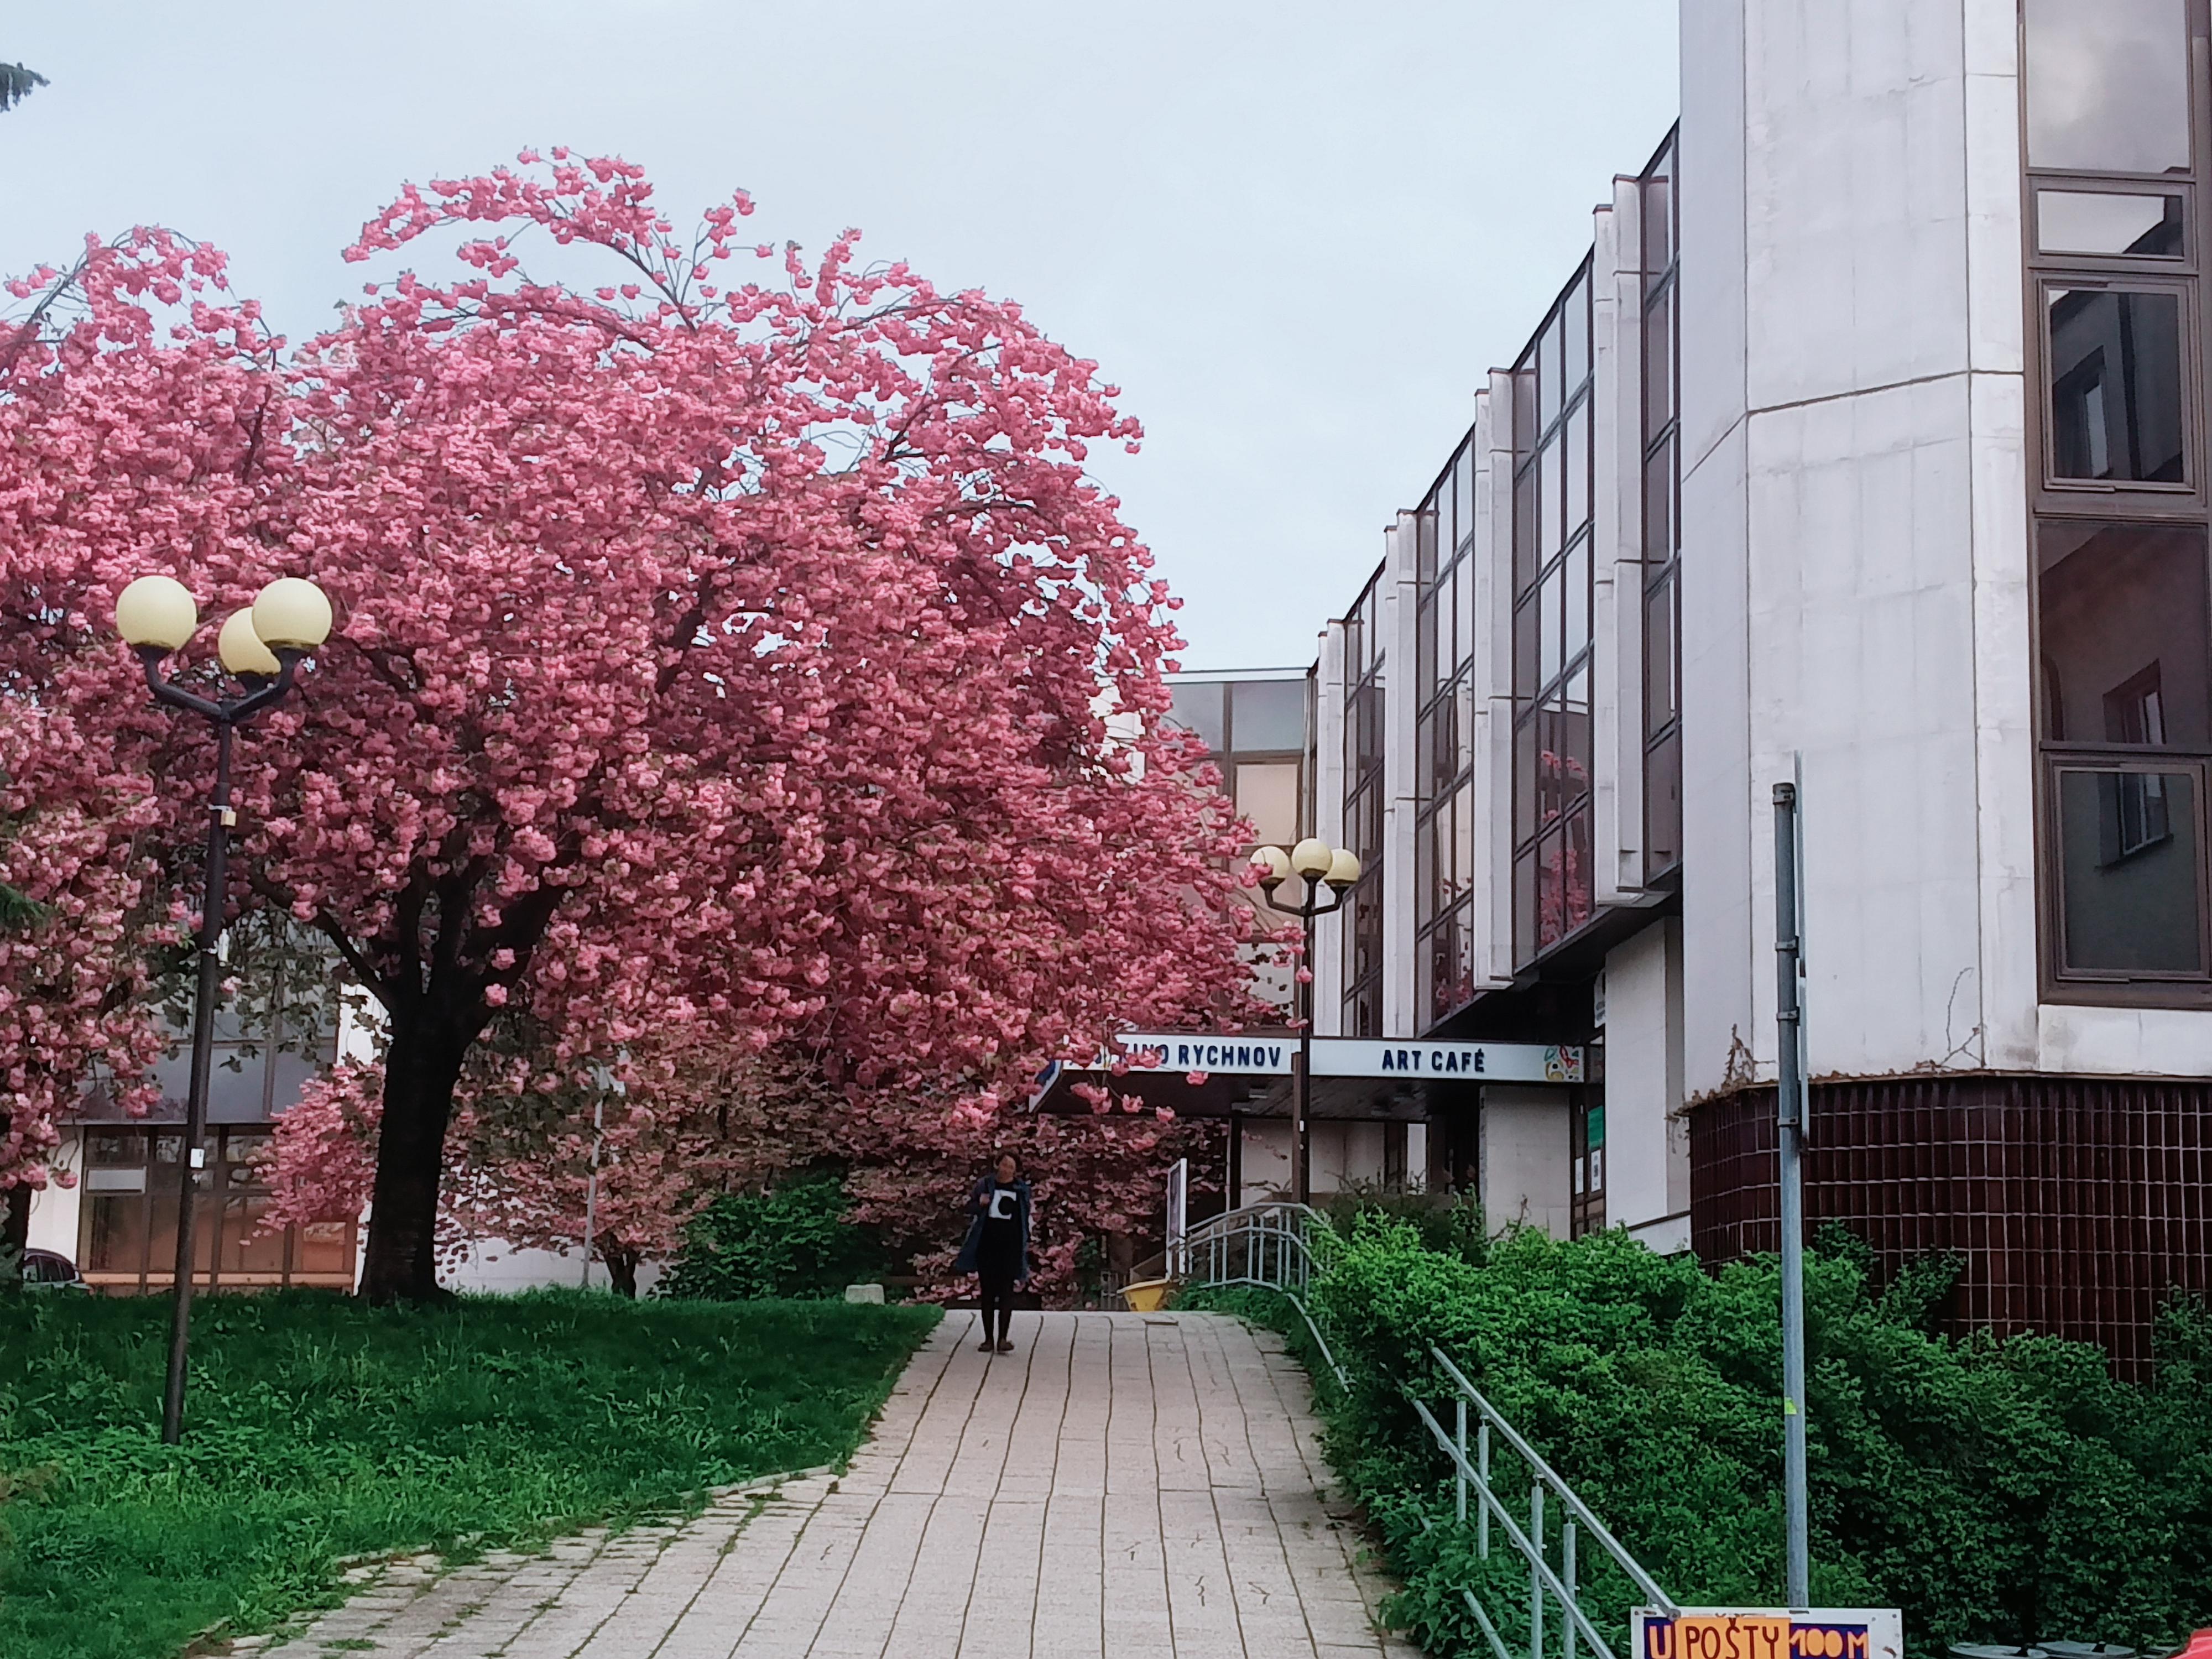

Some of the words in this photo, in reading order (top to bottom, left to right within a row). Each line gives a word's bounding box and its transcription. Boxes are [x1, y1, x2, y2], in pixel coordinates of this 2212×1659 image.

[1178, 1044, 1281, 1067] RYCHNOV
[1382, 1049, 1421, 1071] ART
[1431, 1048, 1485, 1072] CAFÉ
[1649, 1624, 1672, 1659] U
[1685, 1617, 1779, 1659] POŠTY
